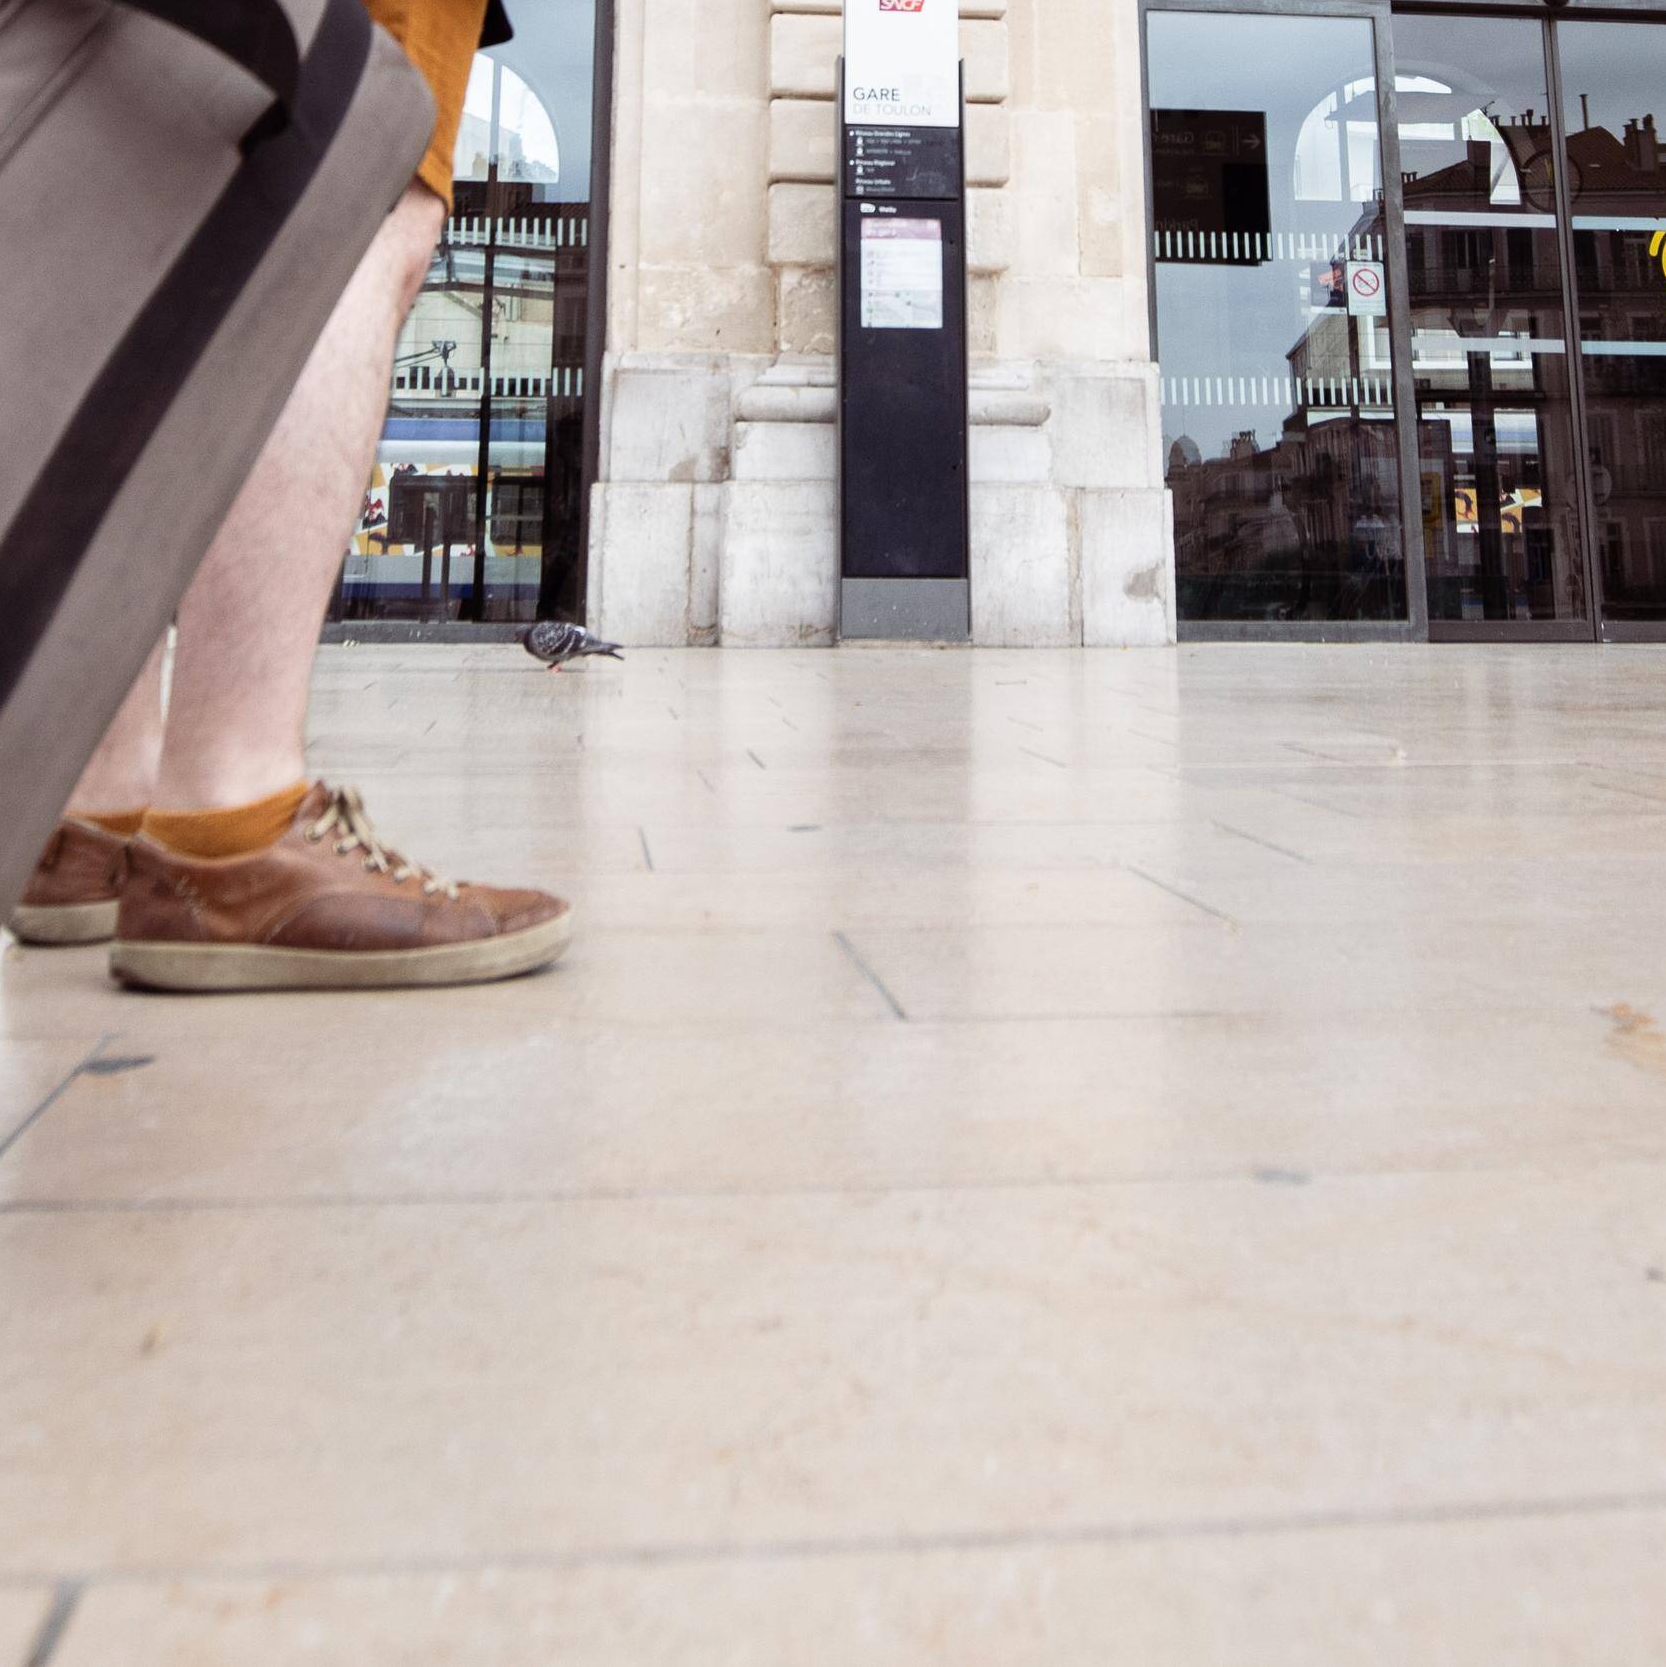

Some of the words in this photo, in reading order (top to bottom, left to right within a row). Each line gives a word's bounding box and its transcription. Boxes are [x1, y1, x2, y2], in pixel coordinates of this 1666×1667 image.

[852, 86, 901, 102] GARE
[852, 103, 871, 116] DE
[876, 103, 932, 117] TOULON
